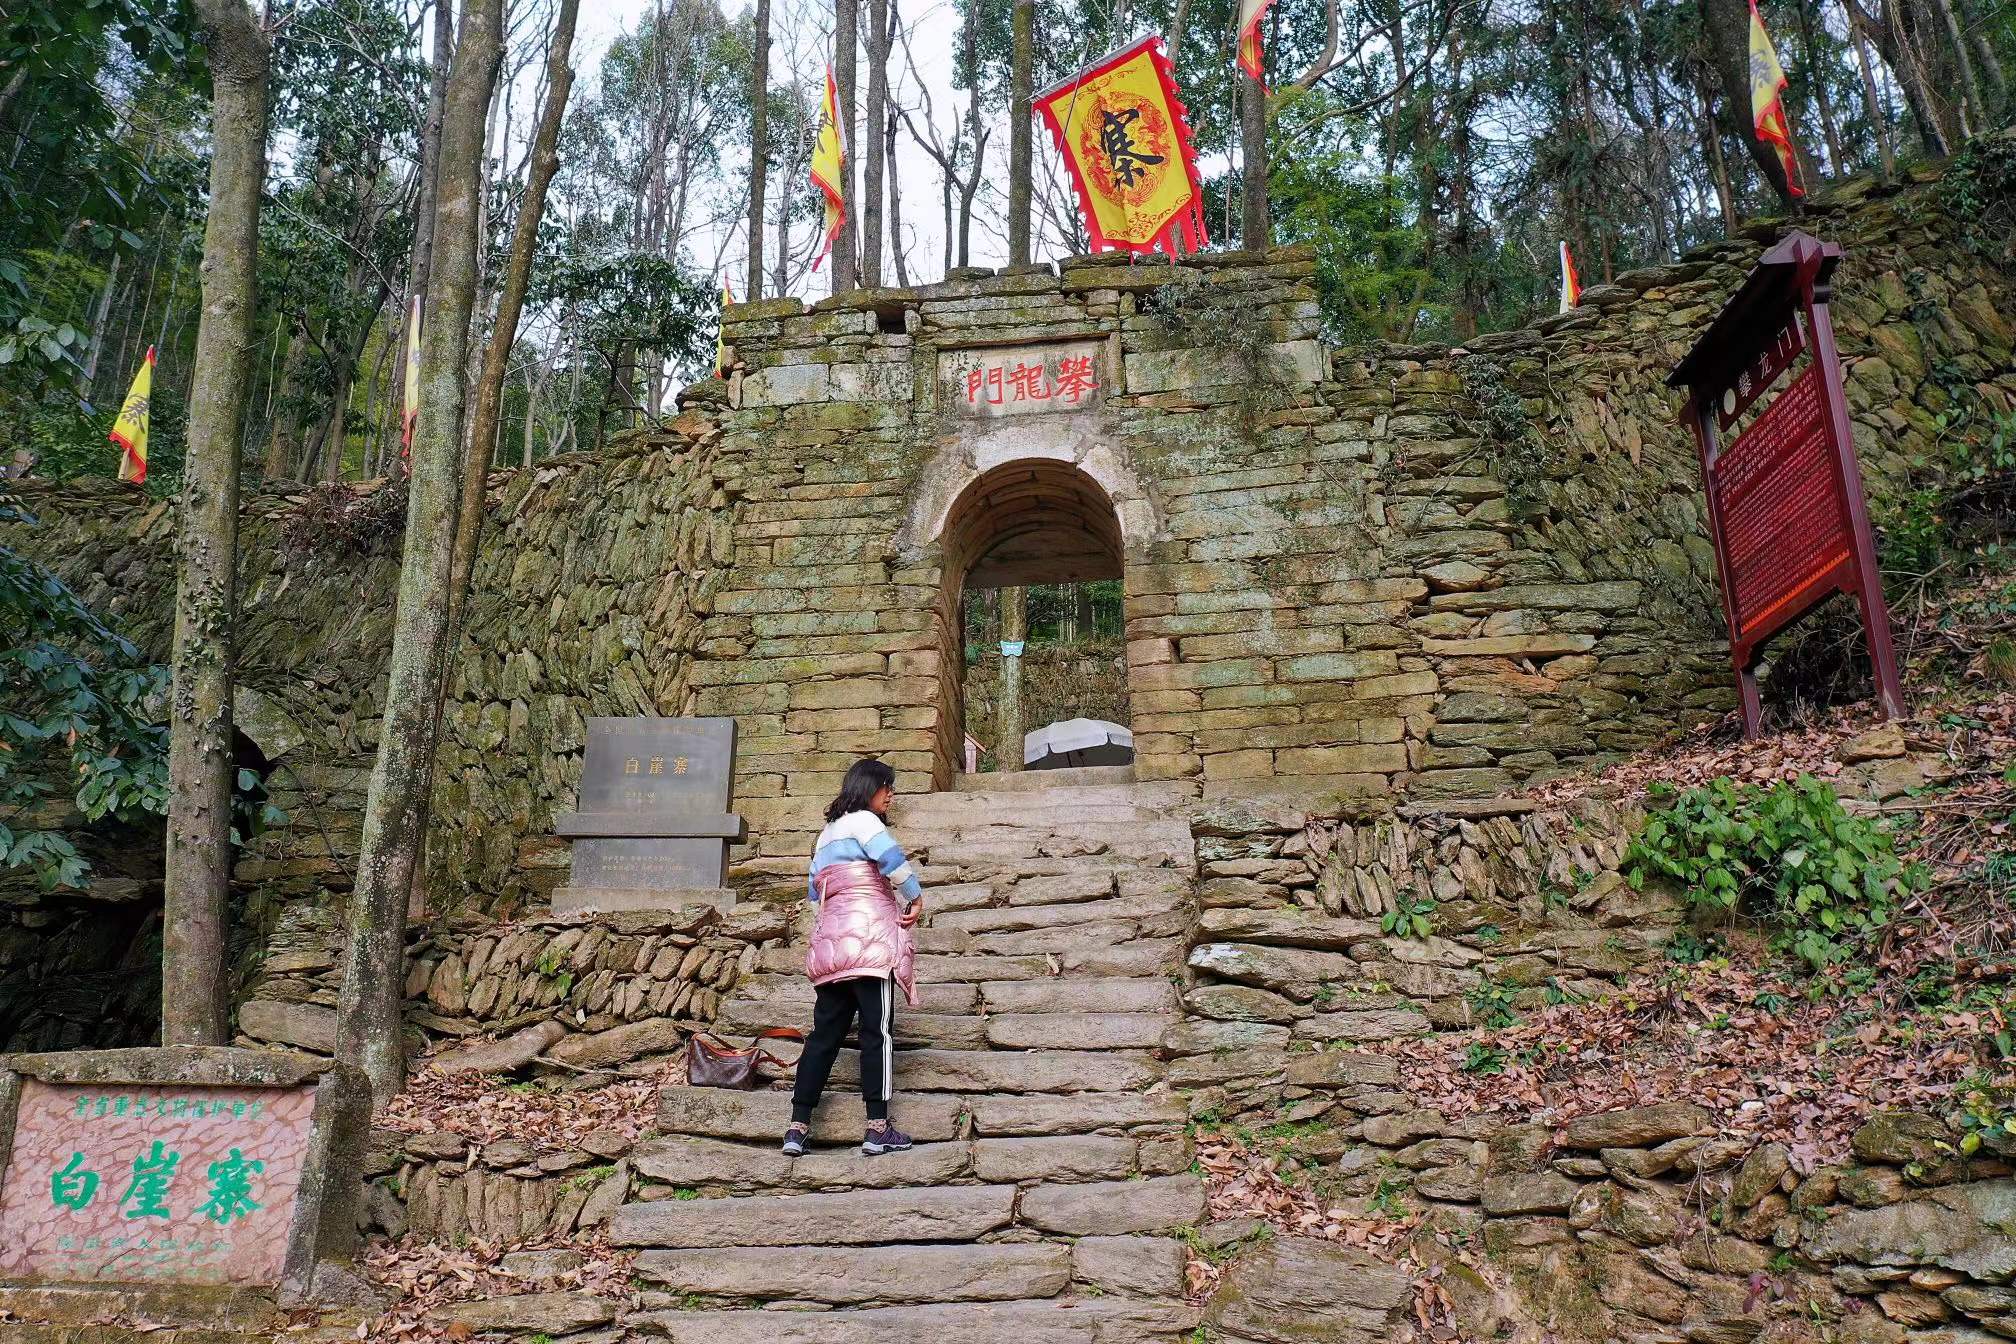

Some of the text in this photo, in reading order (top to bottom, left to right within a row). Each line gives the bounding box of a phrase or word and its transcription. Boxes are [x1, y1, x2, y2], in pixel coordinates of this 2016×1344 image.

[1738, 326, 1792, 398] 攀龙门
[624, 756, 689, 775] 白崖寨
[50, 1140, 265, 1225] 白崖寨
